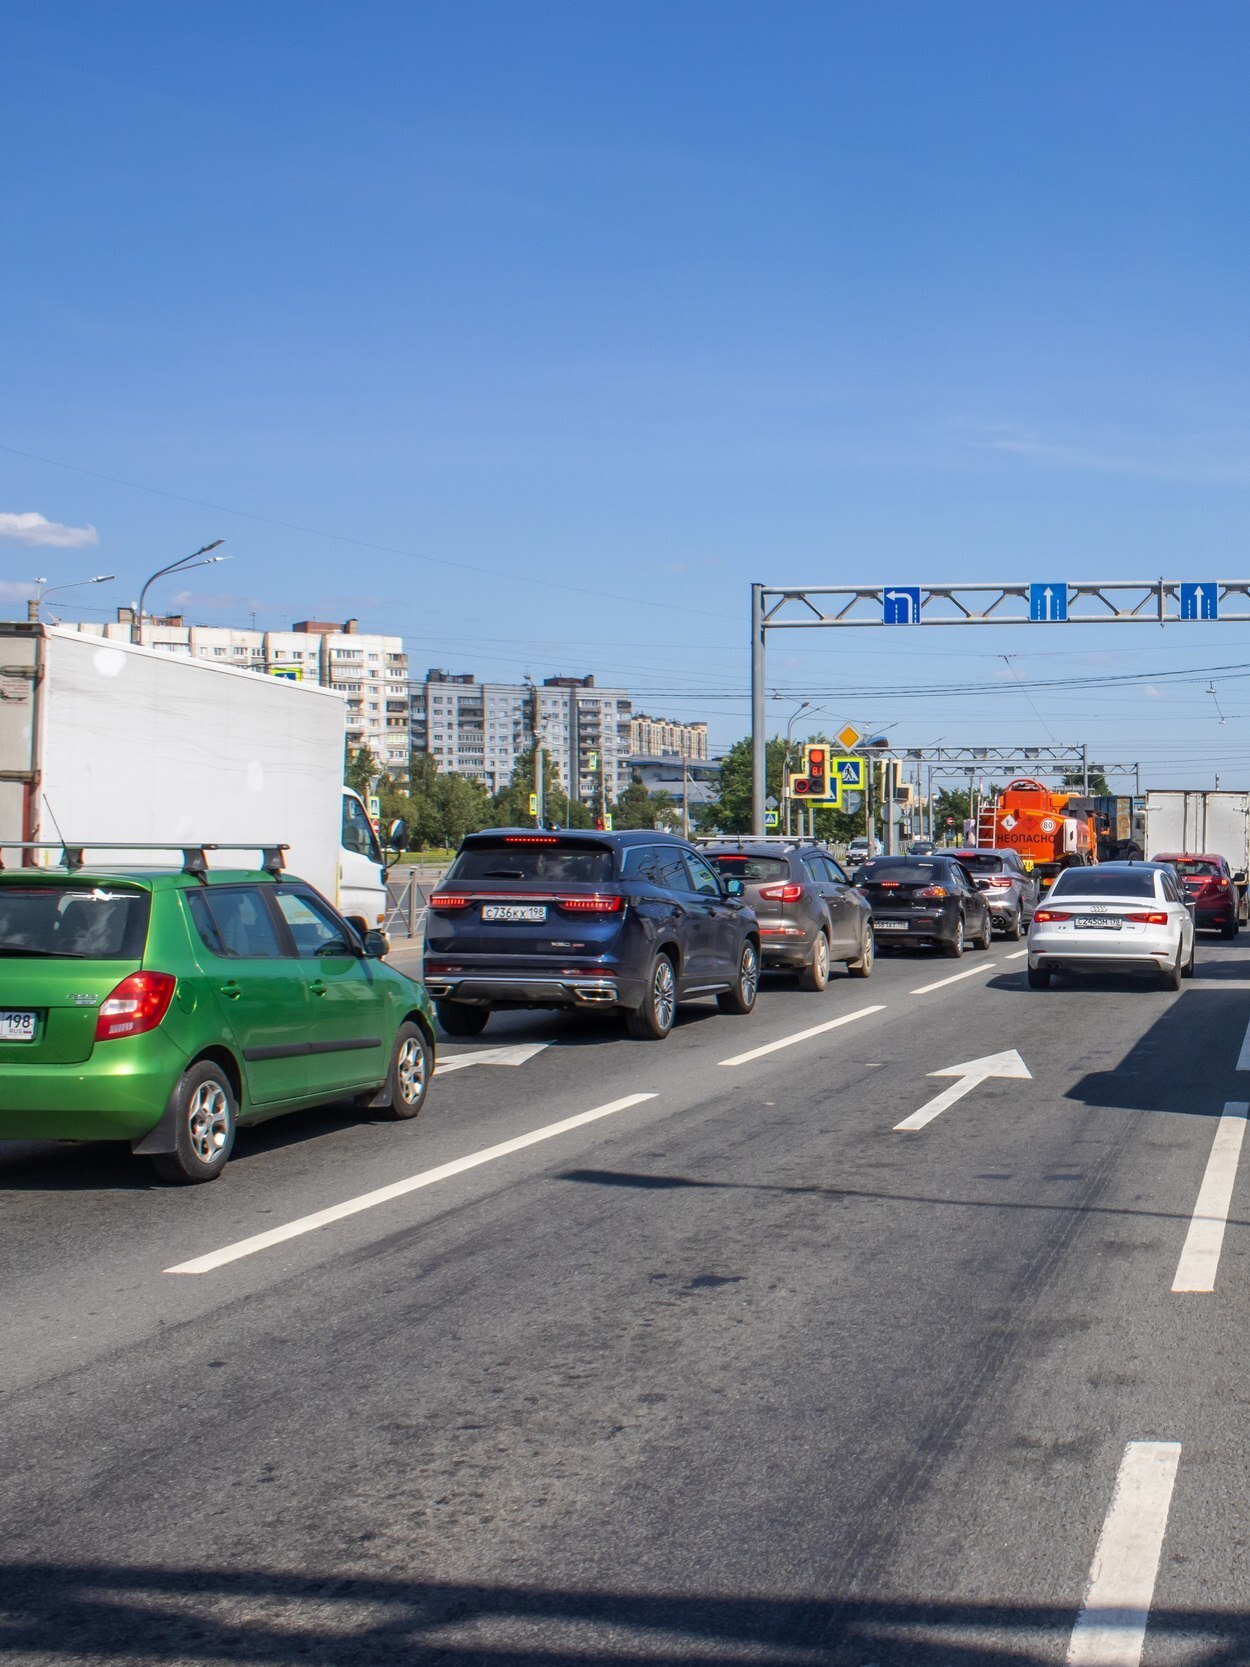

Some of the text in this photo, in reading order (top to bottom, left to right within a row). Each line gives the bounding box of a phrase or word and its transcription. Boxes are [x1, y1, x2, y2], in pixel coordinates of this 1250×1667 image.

[1043, 821, 1053, 829] 80
[528, 907, 544, 916] 198
[5, 1014, 32, 1028] 198
